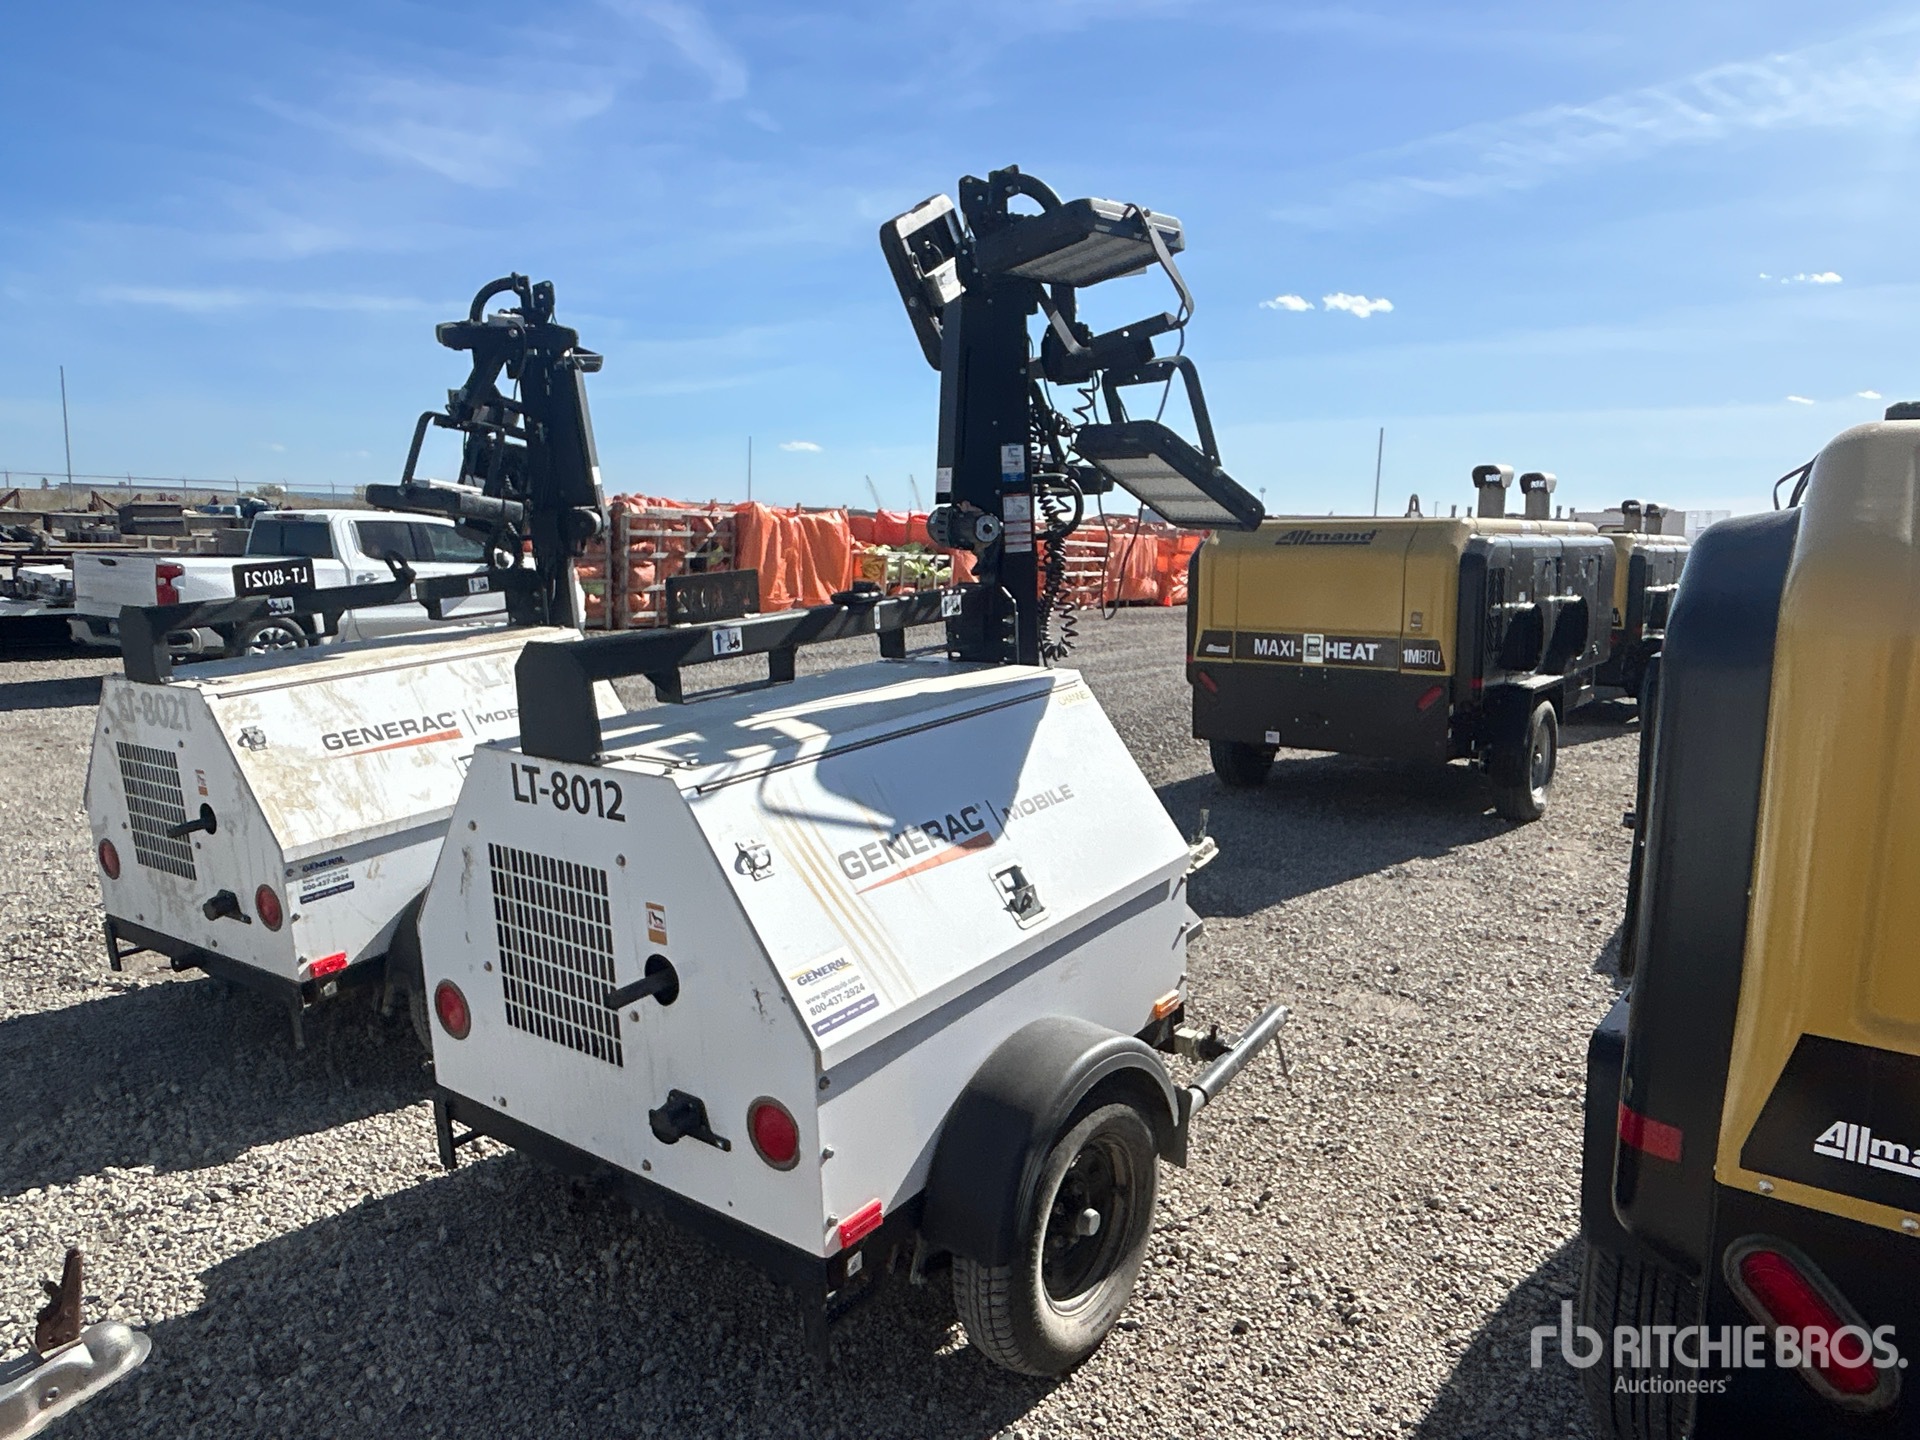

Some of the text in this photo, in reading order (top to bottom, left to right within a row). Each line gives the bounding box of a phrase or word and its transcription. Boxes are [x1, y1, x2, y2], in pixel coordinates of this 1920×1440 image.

[1275, 529, 1377, 545] Allmand
[1325, 642, 1378, 661] HEAT
[1403, 649, 1441, 665] 1MBTU
[321, 712, 457, 751] GENERAC
[511, 762, 626, 823] LT-8012
[837, 783, 1075, 880] GENERAC MOBILE
[797, 957, 849, 986] GENERAL
[810, 983, 866, 1016] 800-437-2924
